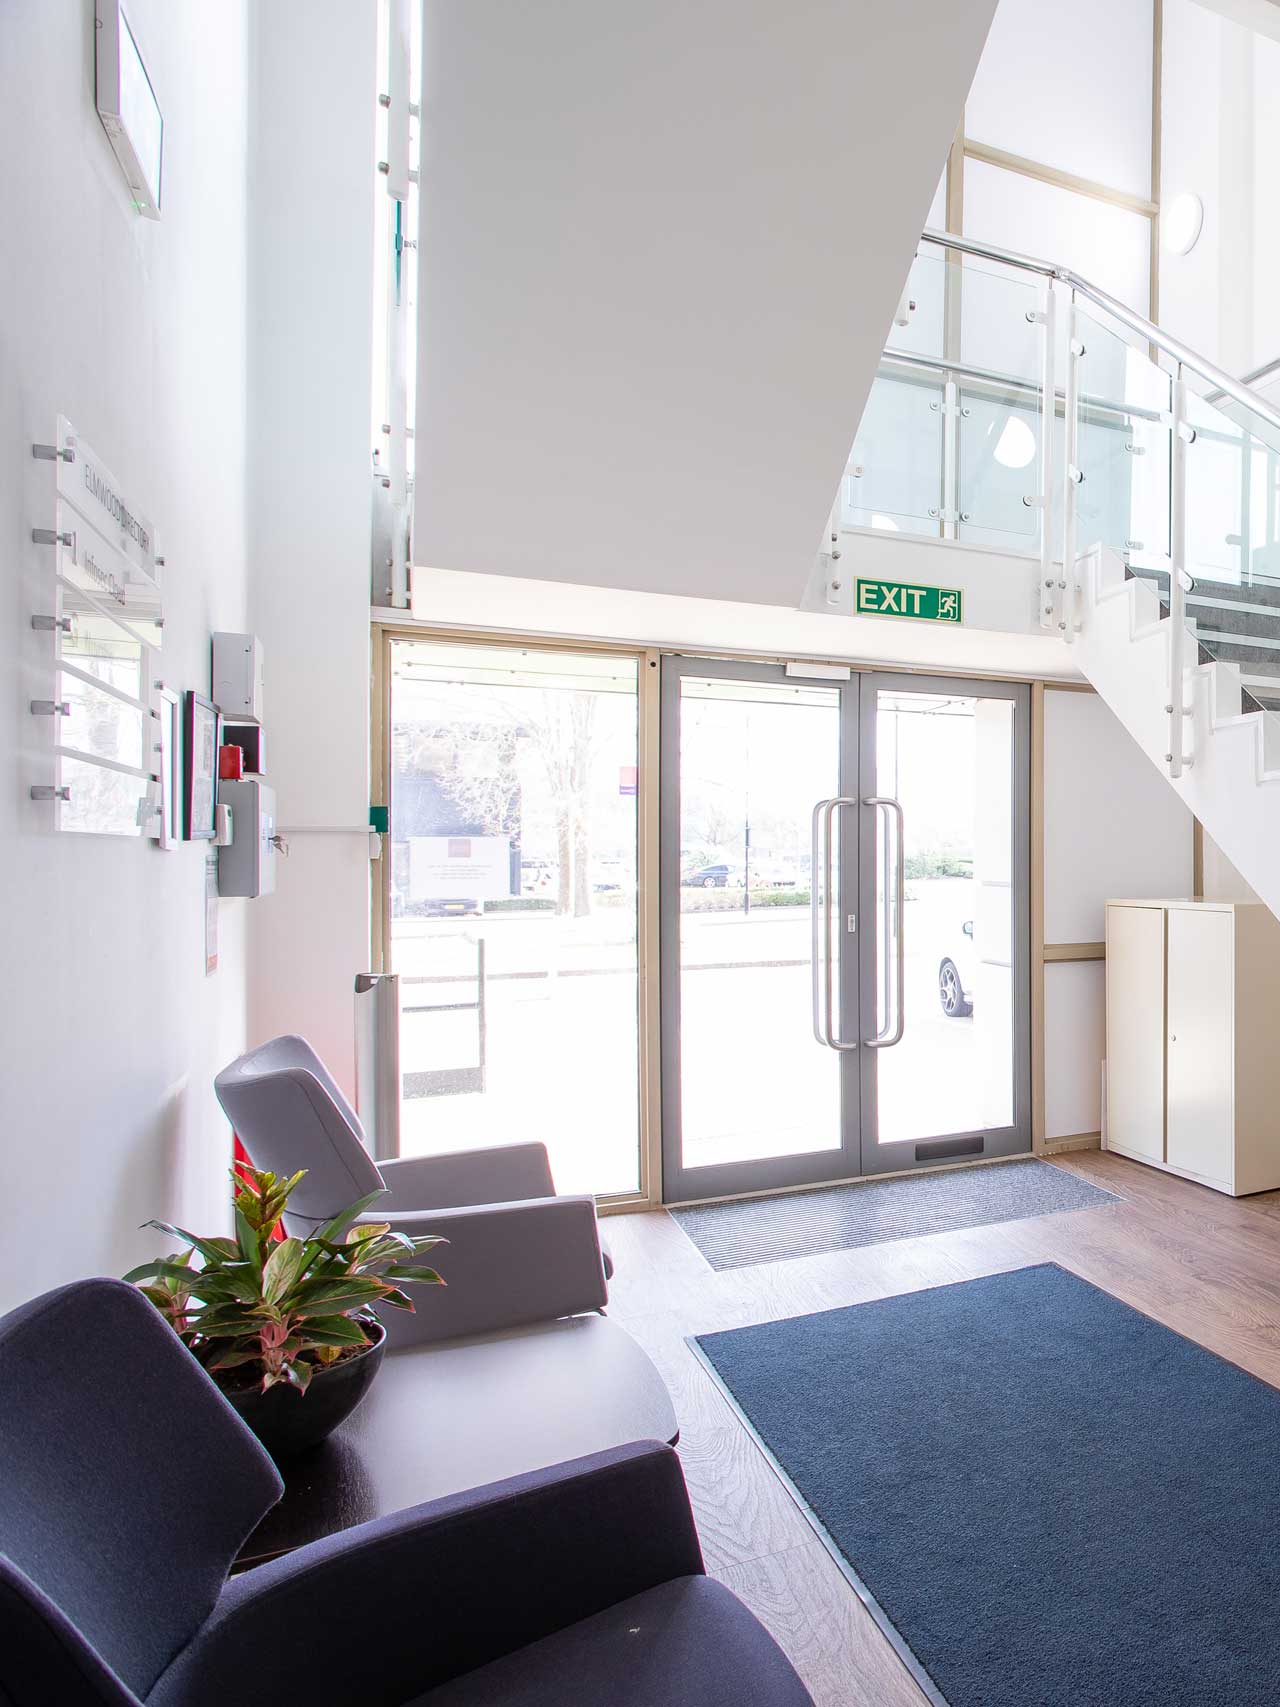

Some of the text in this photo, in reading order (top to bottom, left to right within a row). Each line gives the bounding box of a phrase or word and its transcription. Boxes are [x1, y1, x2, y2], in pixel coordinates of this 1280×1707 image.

[85, 463, 149, 553] ELMWOOD DIRECTORY
[859, 583, 927, 614] EXIT
